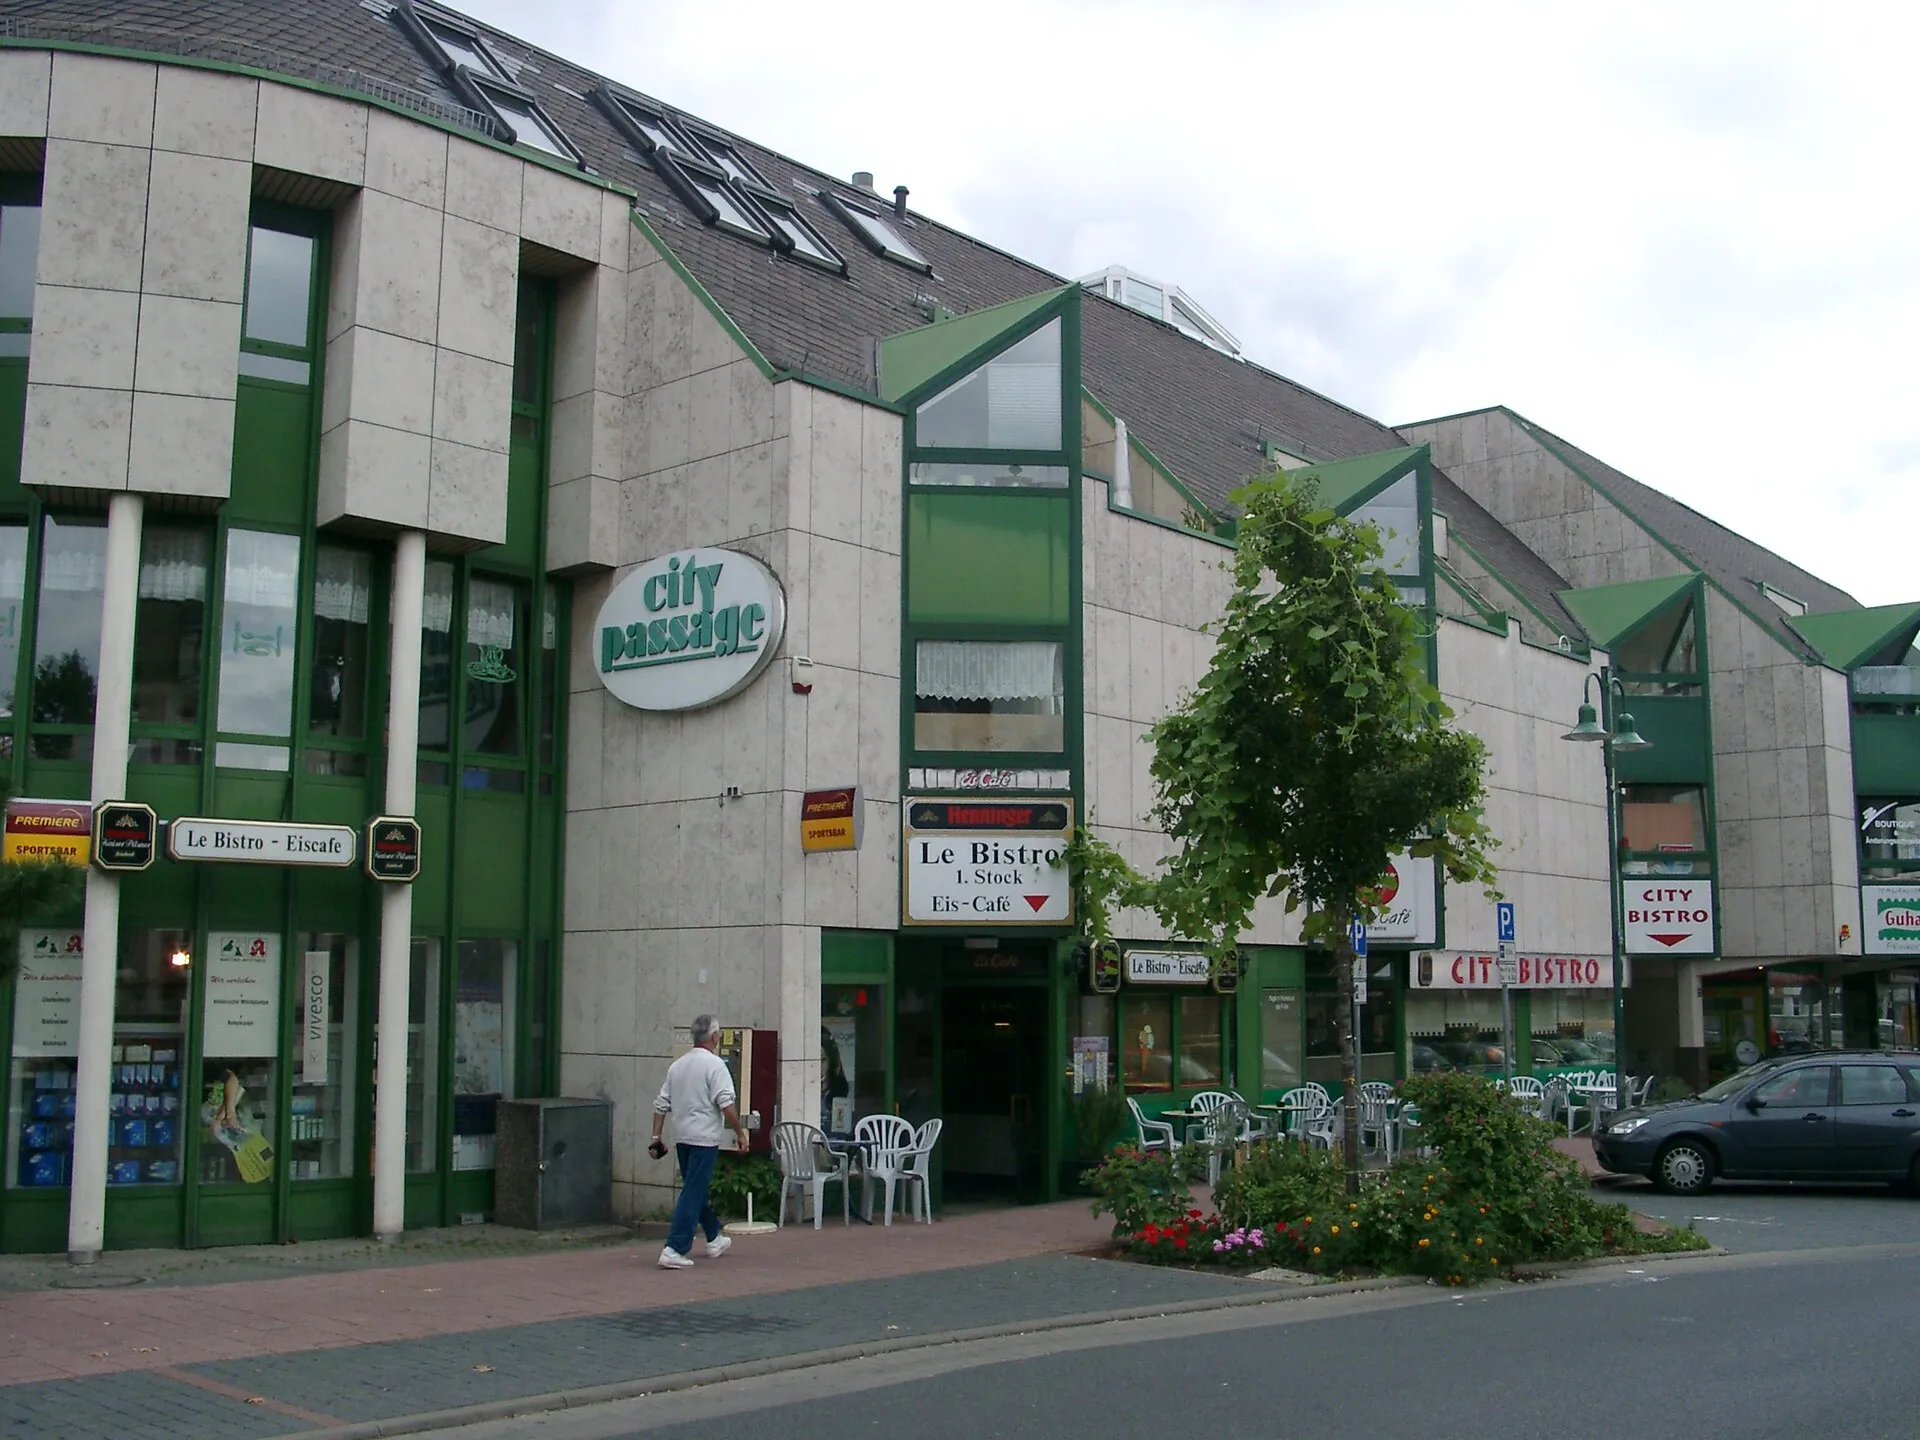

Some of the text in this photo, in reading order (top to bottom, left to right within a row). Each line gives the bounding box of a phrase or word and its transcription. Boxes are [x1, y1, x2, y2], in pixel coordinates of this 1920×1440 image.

[643, 553, 724, 613] city
[601, 602, 766, 673] passage
[960, 769, 1011, 787] Eis Café
[807, 801, 848, 813] PREMIERE
[947, 805, 1034, 827] Henninger
[14, 815, 81, 828] PREMIERE
[187, 830, 208, 848] Le
[214, 831, 264, 850] Bistro
[286, 834, 342, 854] Eiscafe
[808, 827, 846, 840] SPORTSBAR
[16, 845, 78, 857] SPORTSBAR
[920, 842, 1060, 865] Le Bistro
[956, 869, 1023, 885] 1. Stock
[932, 894, 1011, 912] Eis-Café
[1642, 889, 1693, 903] CITY
[1501, 907, 1511, 936] P
[1627, 909, 1709, 923] BISTRO
[1354, 919, 1364, 951] P
[1132, 958, 1143, 974] Le
[1146, 959, 1171, 975] Bistro
[1451, 956, 1500, 985] CIT
[1518, 957, 1600, 984] BISTRO
